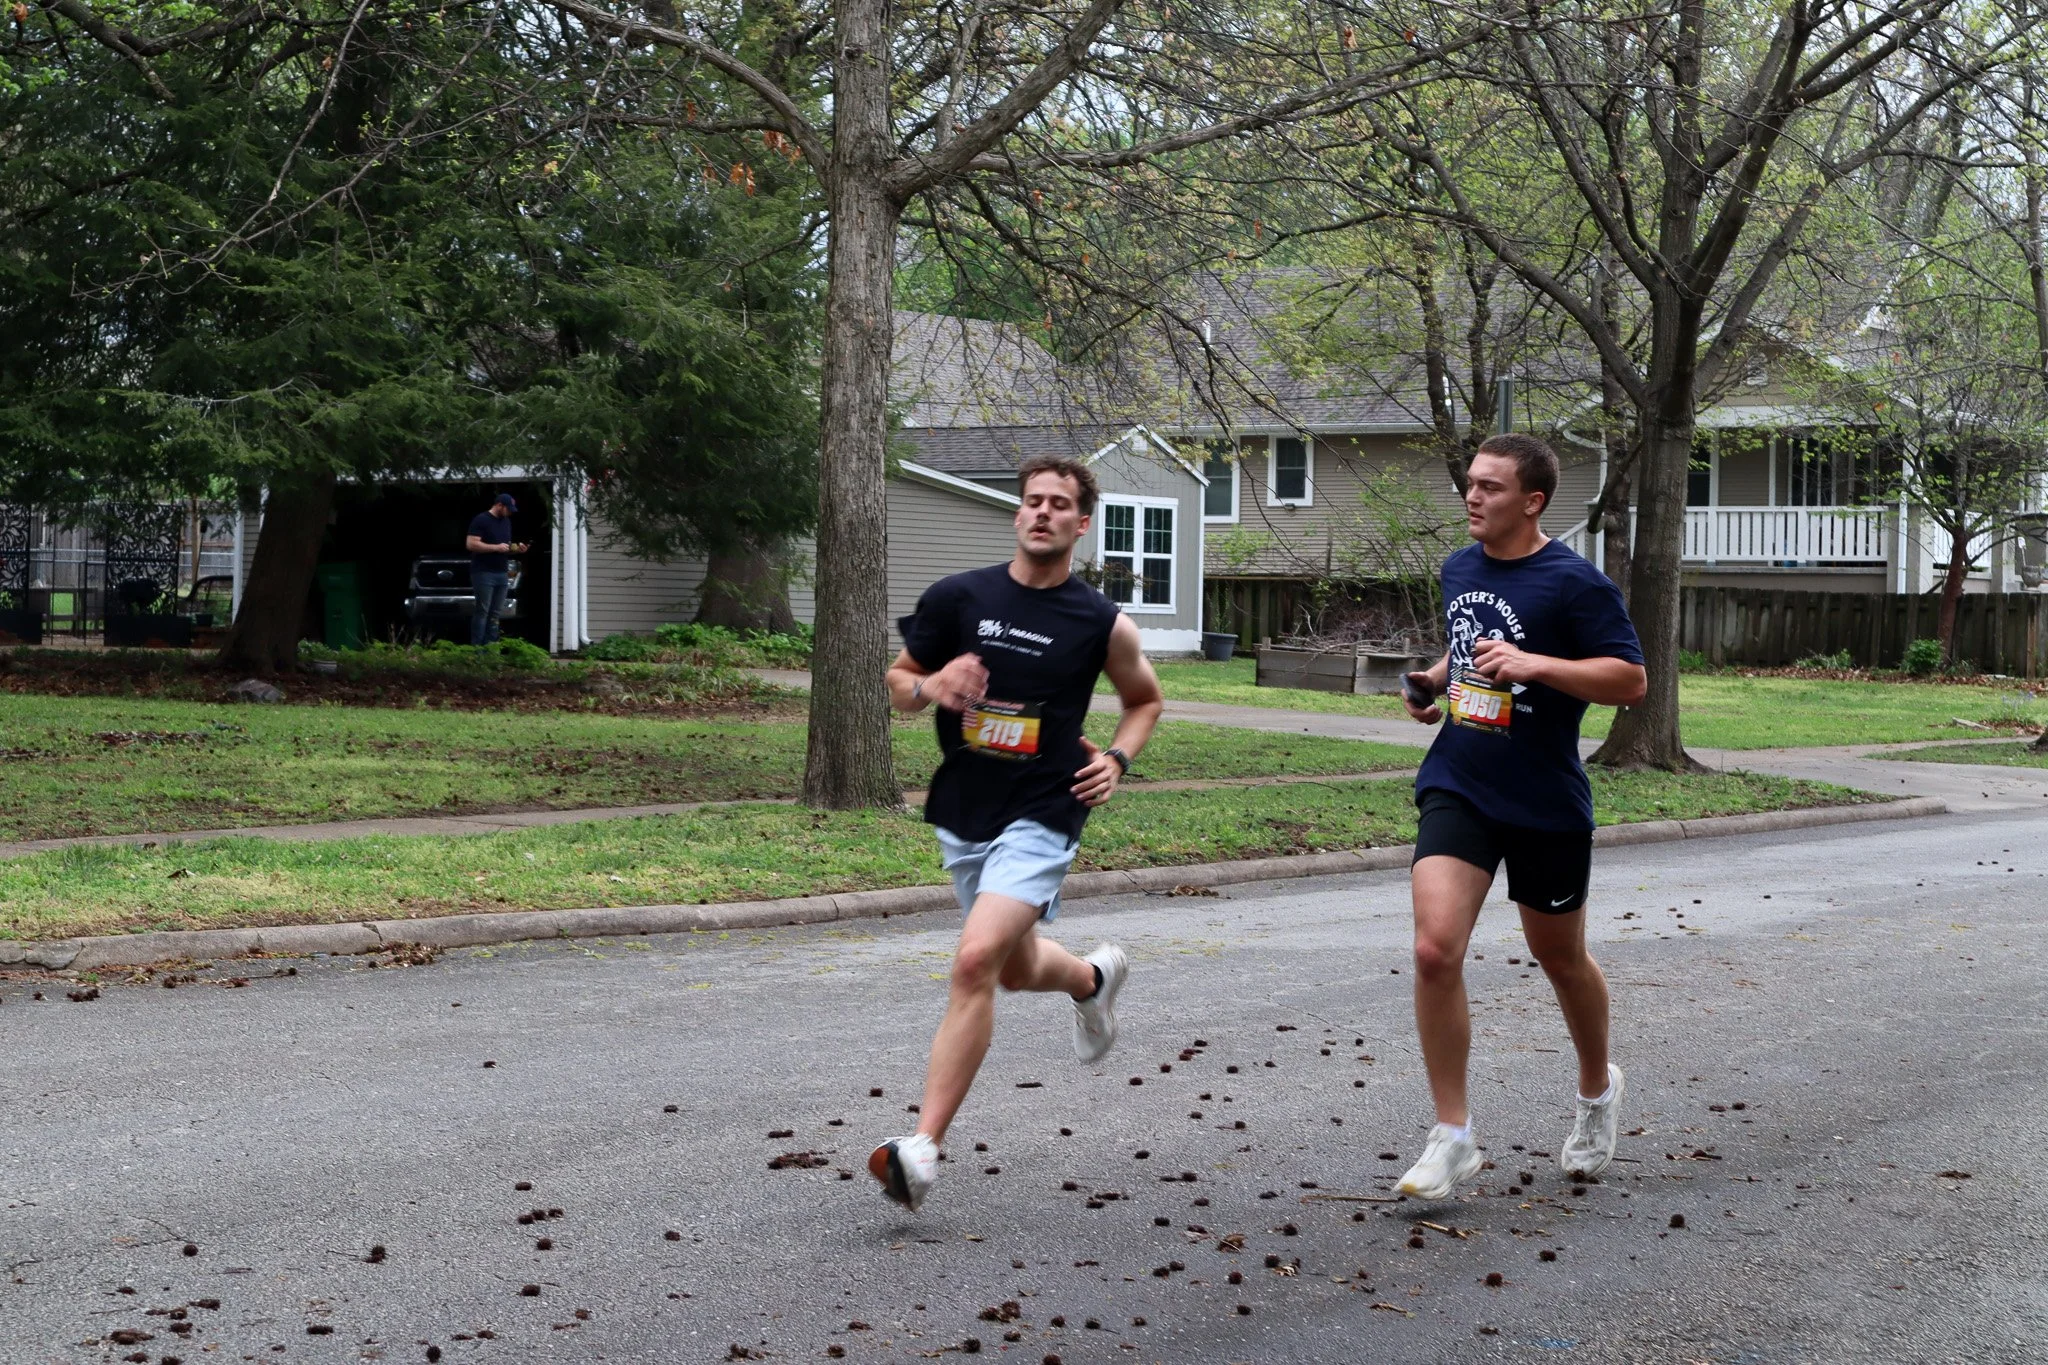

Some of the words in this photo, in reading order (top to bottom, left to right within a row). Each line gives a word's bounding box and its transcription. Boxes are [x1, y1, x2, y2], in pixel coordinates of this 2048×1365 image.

[1495, 598, 1525, 641] HOUSE
[1458, 689, 1502, 720] 2050
[1516, 703, 1532, 713] RUN
[978, 718, 1025, 747] 2119
